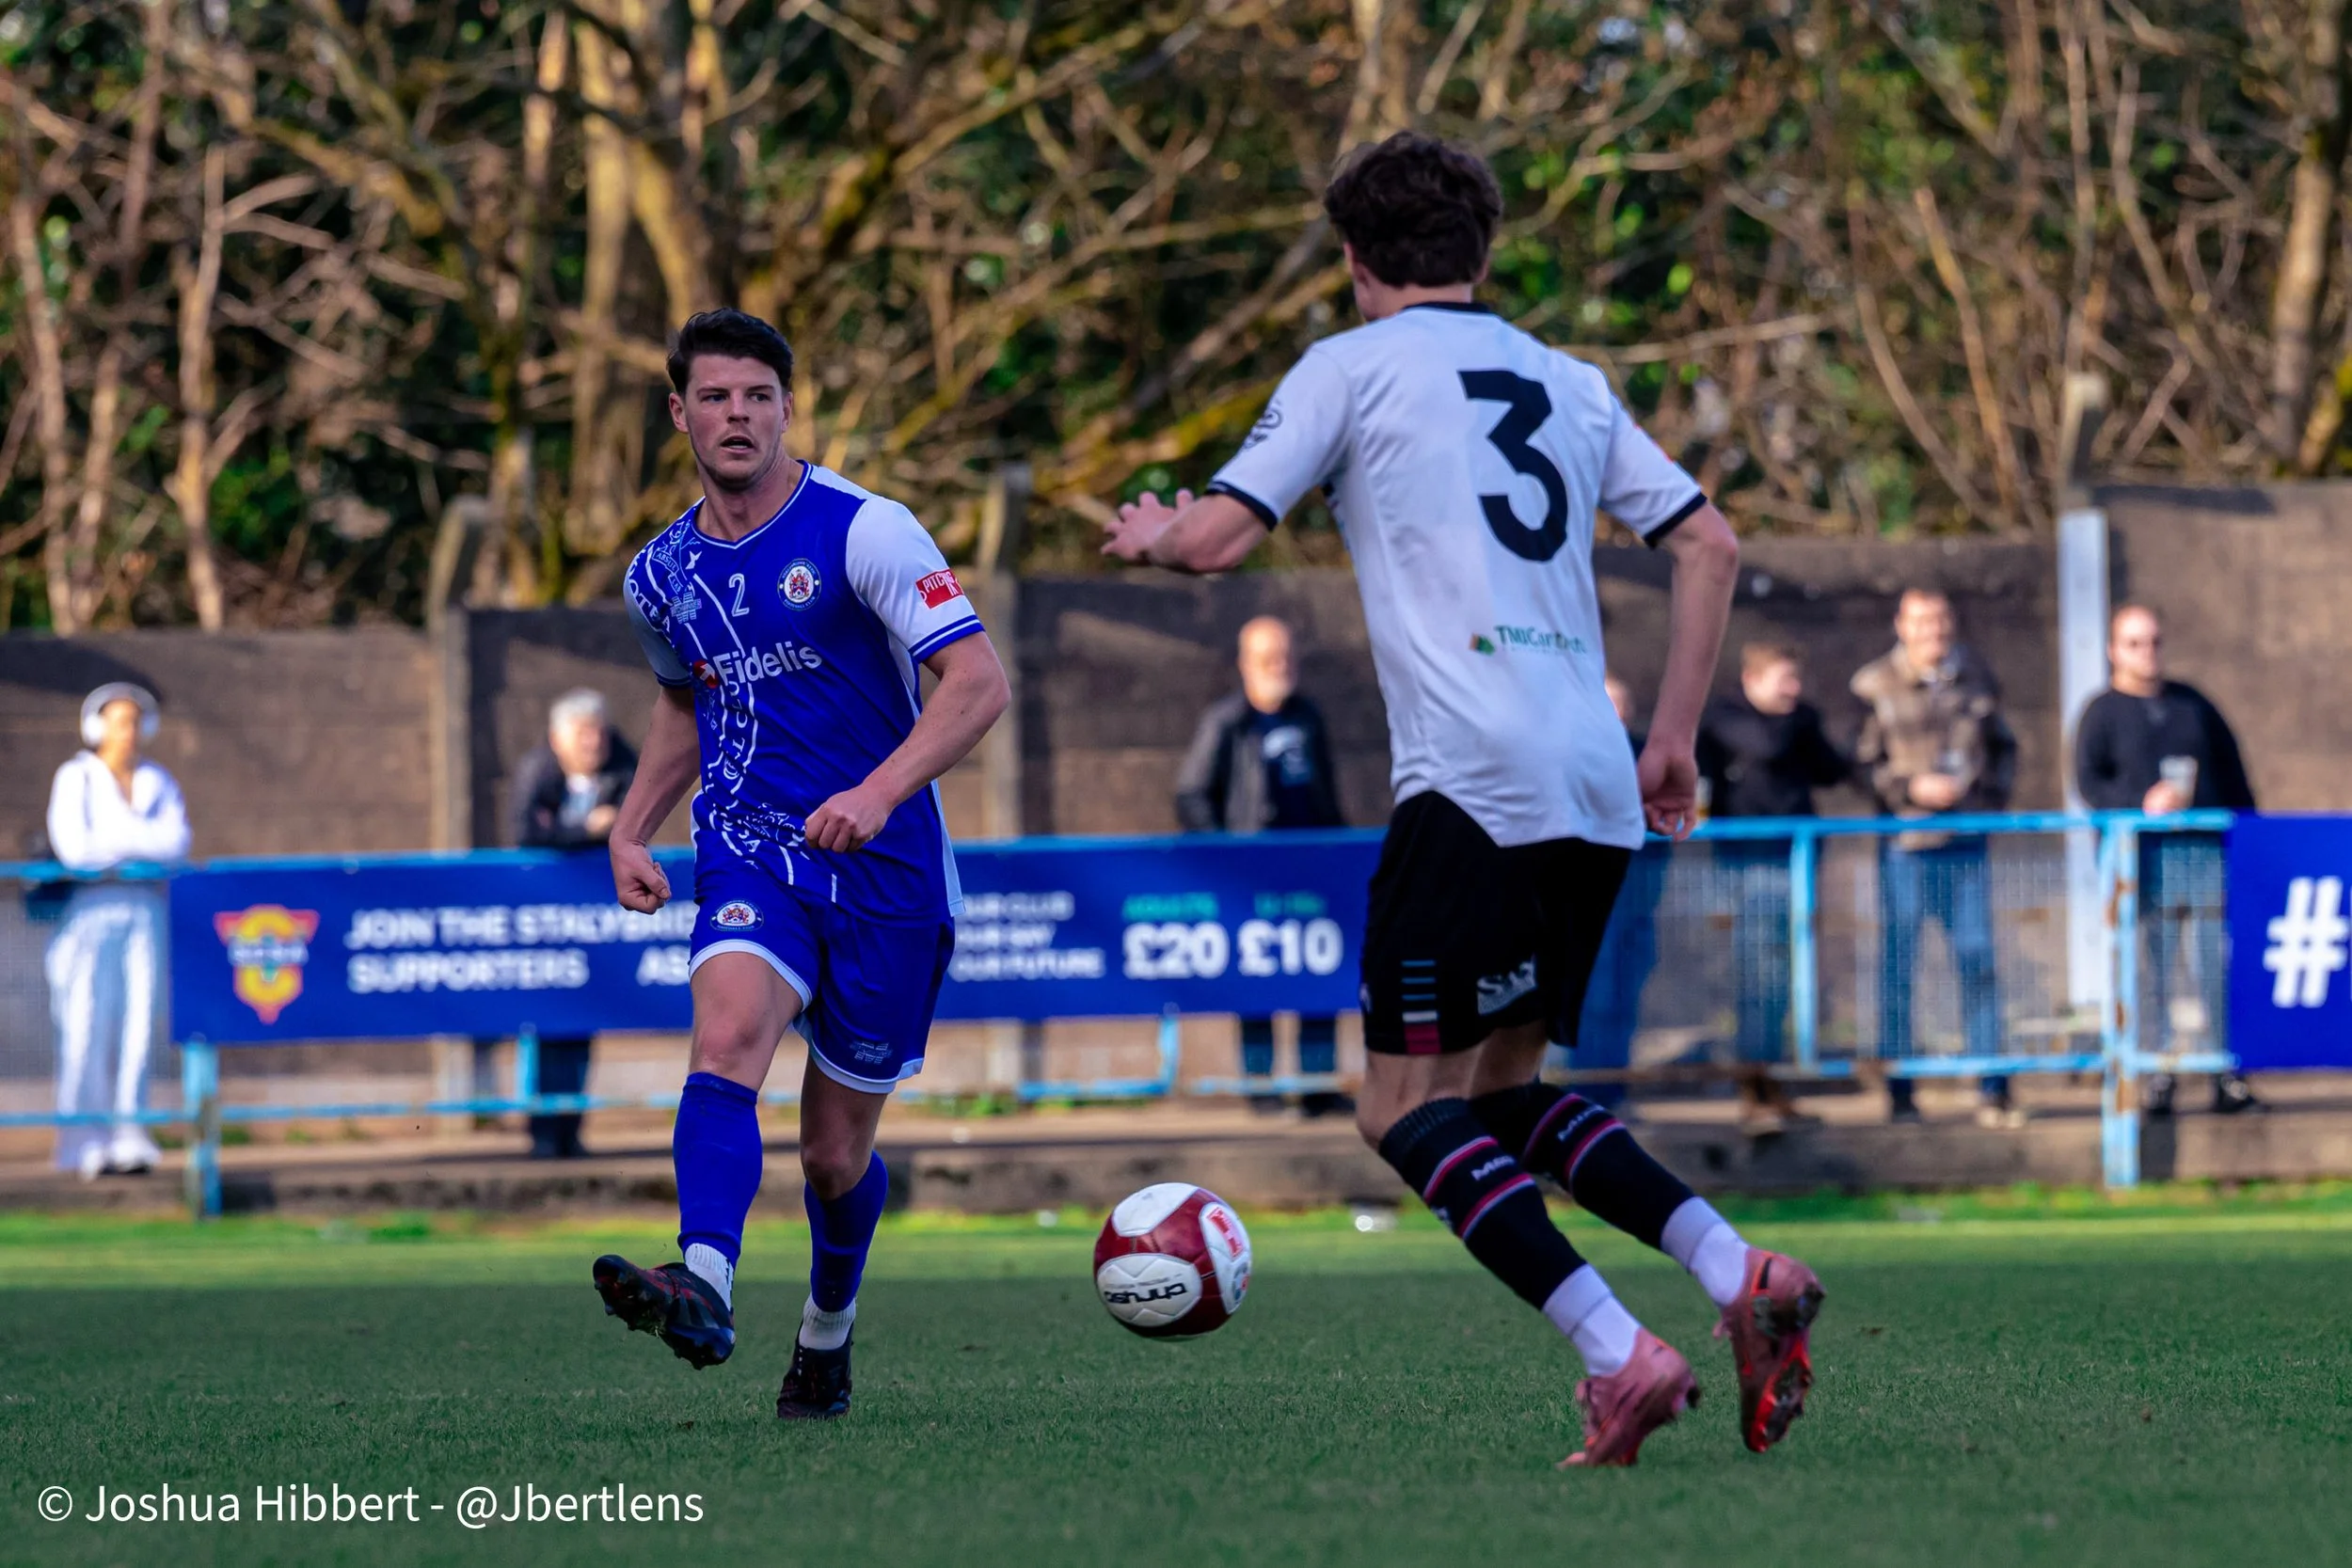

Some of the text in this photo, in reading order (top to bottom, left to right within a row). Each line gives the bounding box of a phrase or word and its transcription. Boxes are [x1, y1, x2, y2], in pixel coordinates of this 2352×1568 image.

[1457, 370, 1569, 562] 3
[728, 572, 750, 617] 2
[712, 641, 822, 686] Fidelis
[346, 909, 436, 949] JOIN
[437, 905, 513, 946] THE
[1123, 918, 1343, 980] £20 £10
[348, 948, 590, 993] SUPPORTERS
